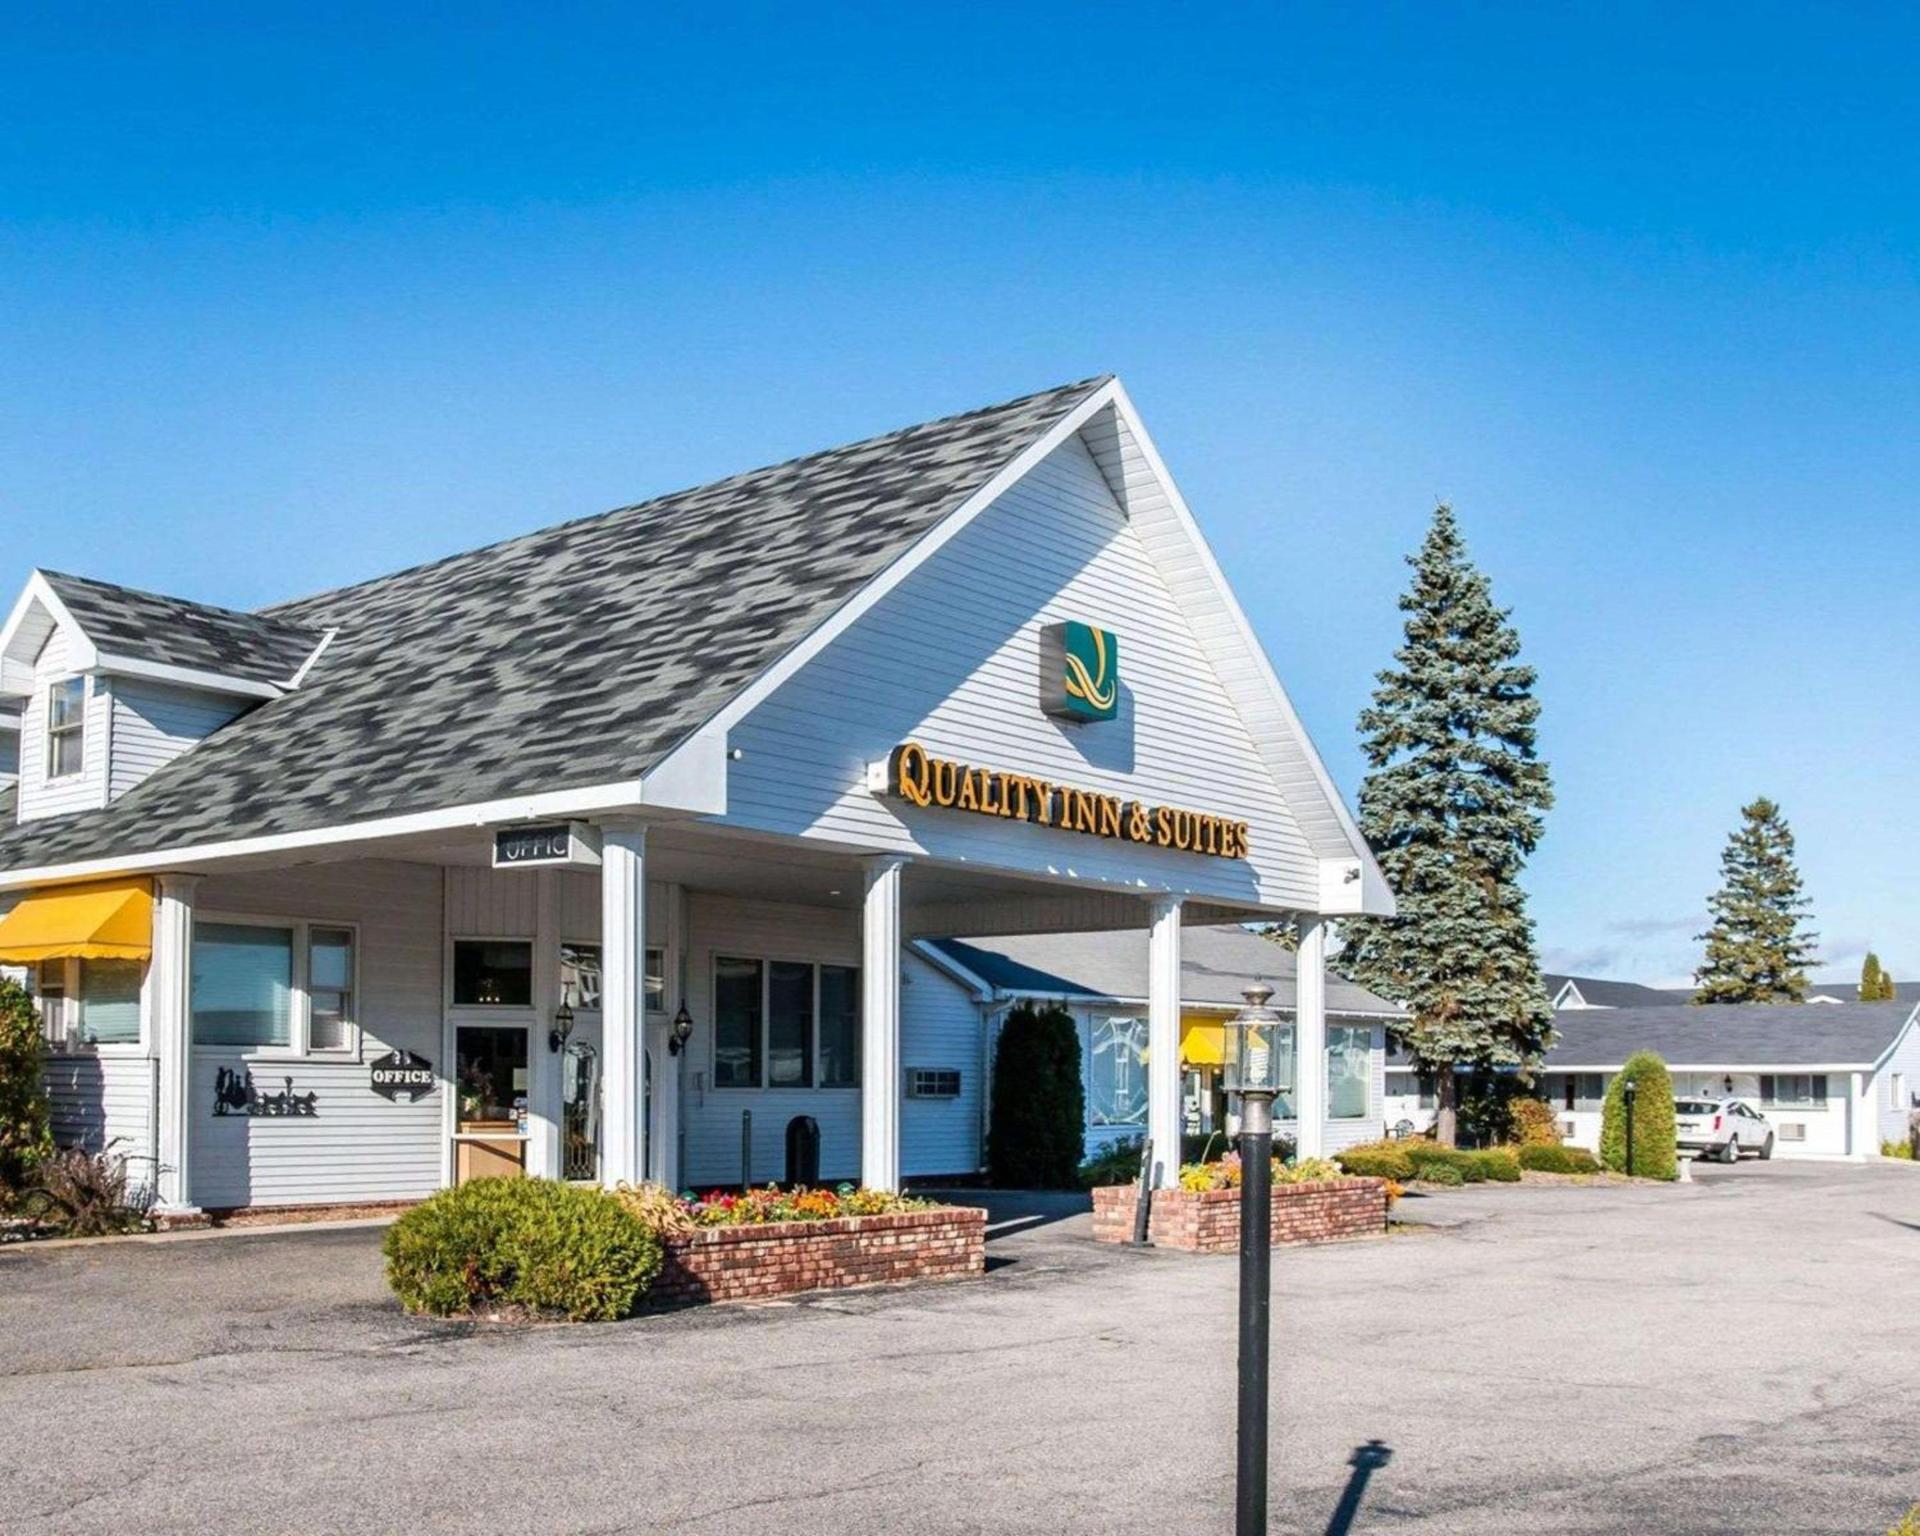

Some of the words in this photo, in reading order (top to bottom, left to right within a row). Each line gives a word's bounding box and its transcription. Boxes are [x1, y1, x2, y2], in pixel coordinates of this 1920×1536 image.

[899, 742, 1052, 823] QUALITY
[1061, 787, 1121, 838] INN
[1129, 800, 1150, 843] &
[1157, 805, 1249, 859] SUITES
[372, 1069, 432, 1084] OFFICE
